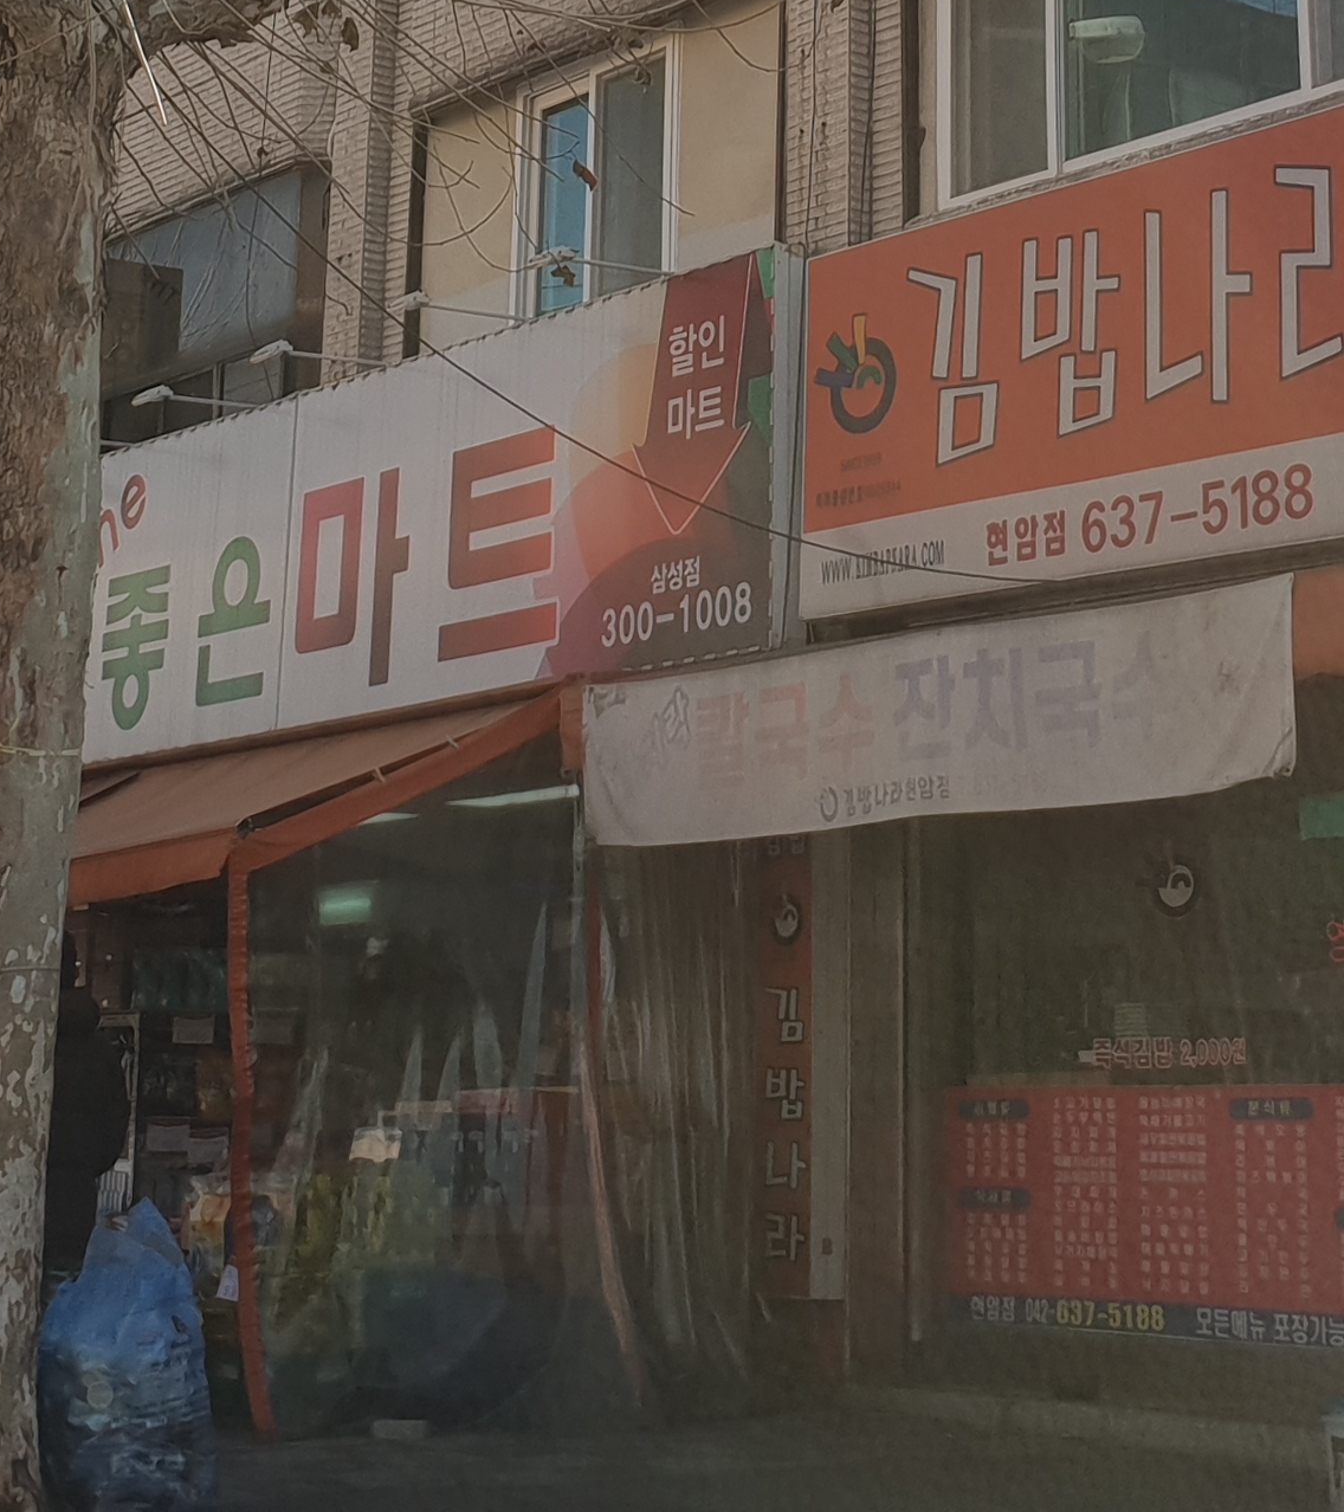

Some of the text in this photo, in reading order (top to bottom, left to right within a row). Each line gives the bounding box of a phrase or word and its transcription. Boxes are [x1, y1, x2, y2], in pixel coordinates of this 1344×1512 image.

[668, 315, 725, 377] 할인
[667, 385, 724, 440] 마트
[985, 463, 1314, 568] 현암점 637-5188
[650, 555, 701, 594] 삼성점
[602, 582, 752, 647] 300-1008
[763, 986, 808, 1263] 김밥나라
[970, 1295, 1016, 1322] 현암점
